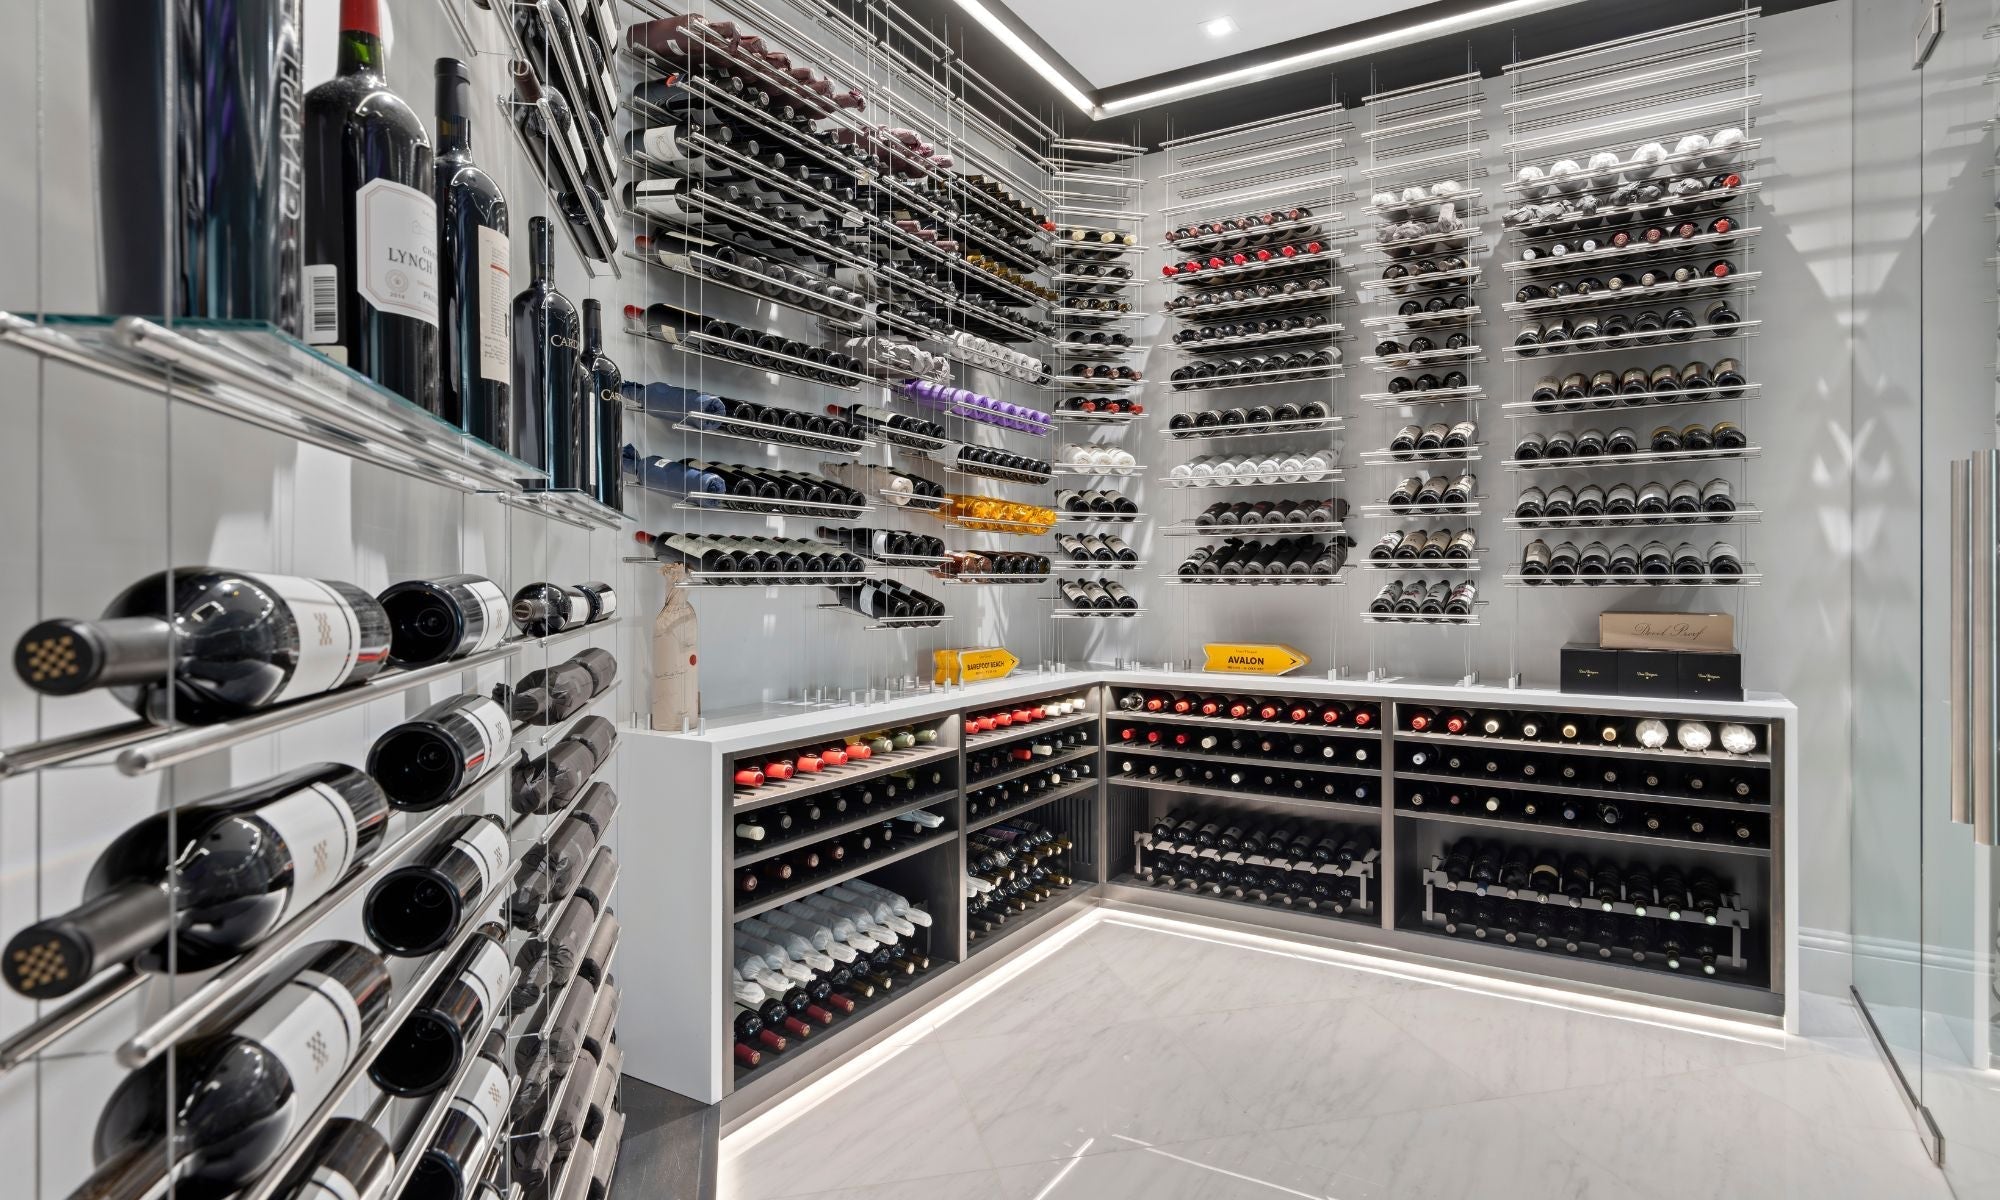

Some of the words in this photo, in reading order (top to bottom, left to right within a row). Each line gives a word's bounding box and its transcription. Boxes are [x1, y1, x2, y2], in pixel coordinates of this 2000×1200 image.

[387, 247, 433, 275] LYNCH
[967, 662, 990, 671] BAREFOOT
[990, 660, 1004, 668] BEACH
[1228, 655, 1264, 665] AVALON
